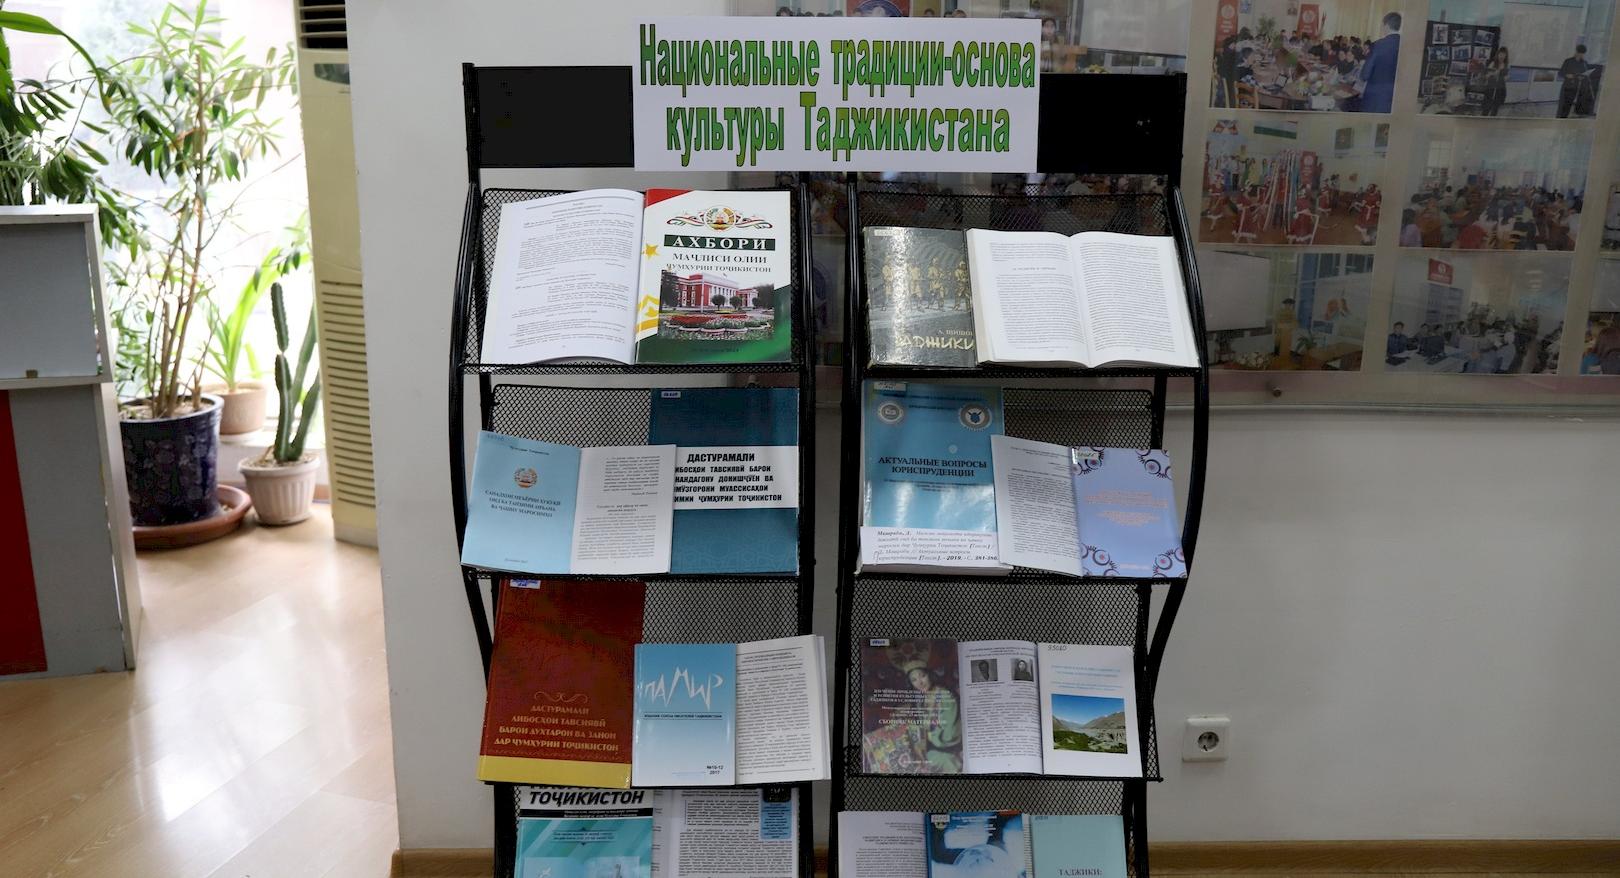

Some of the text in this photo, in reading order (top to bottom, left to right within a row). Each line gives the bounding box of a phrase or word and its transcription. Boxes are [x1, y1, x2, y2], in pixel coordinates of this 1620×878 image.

[639, 24, 1036, 101] Национальные традиции-основа
[666, 91, 1010, 168] культуры Таджикистана
[672, 236, 767, 250] АХБОРИ
[687, 453, 755, 463] ДАСТУРАМАЛИ
[878, 457, 987, 468] АКТУАЛЬНЫЕ ВОПРОСЫ
[891, 466, 975, 477] ЮРИСПРУДЕНЦИИ
[643, 665, 725, 712] ПАМИР
[530, 790, 646, 807] ТОҶИКИСТОН
